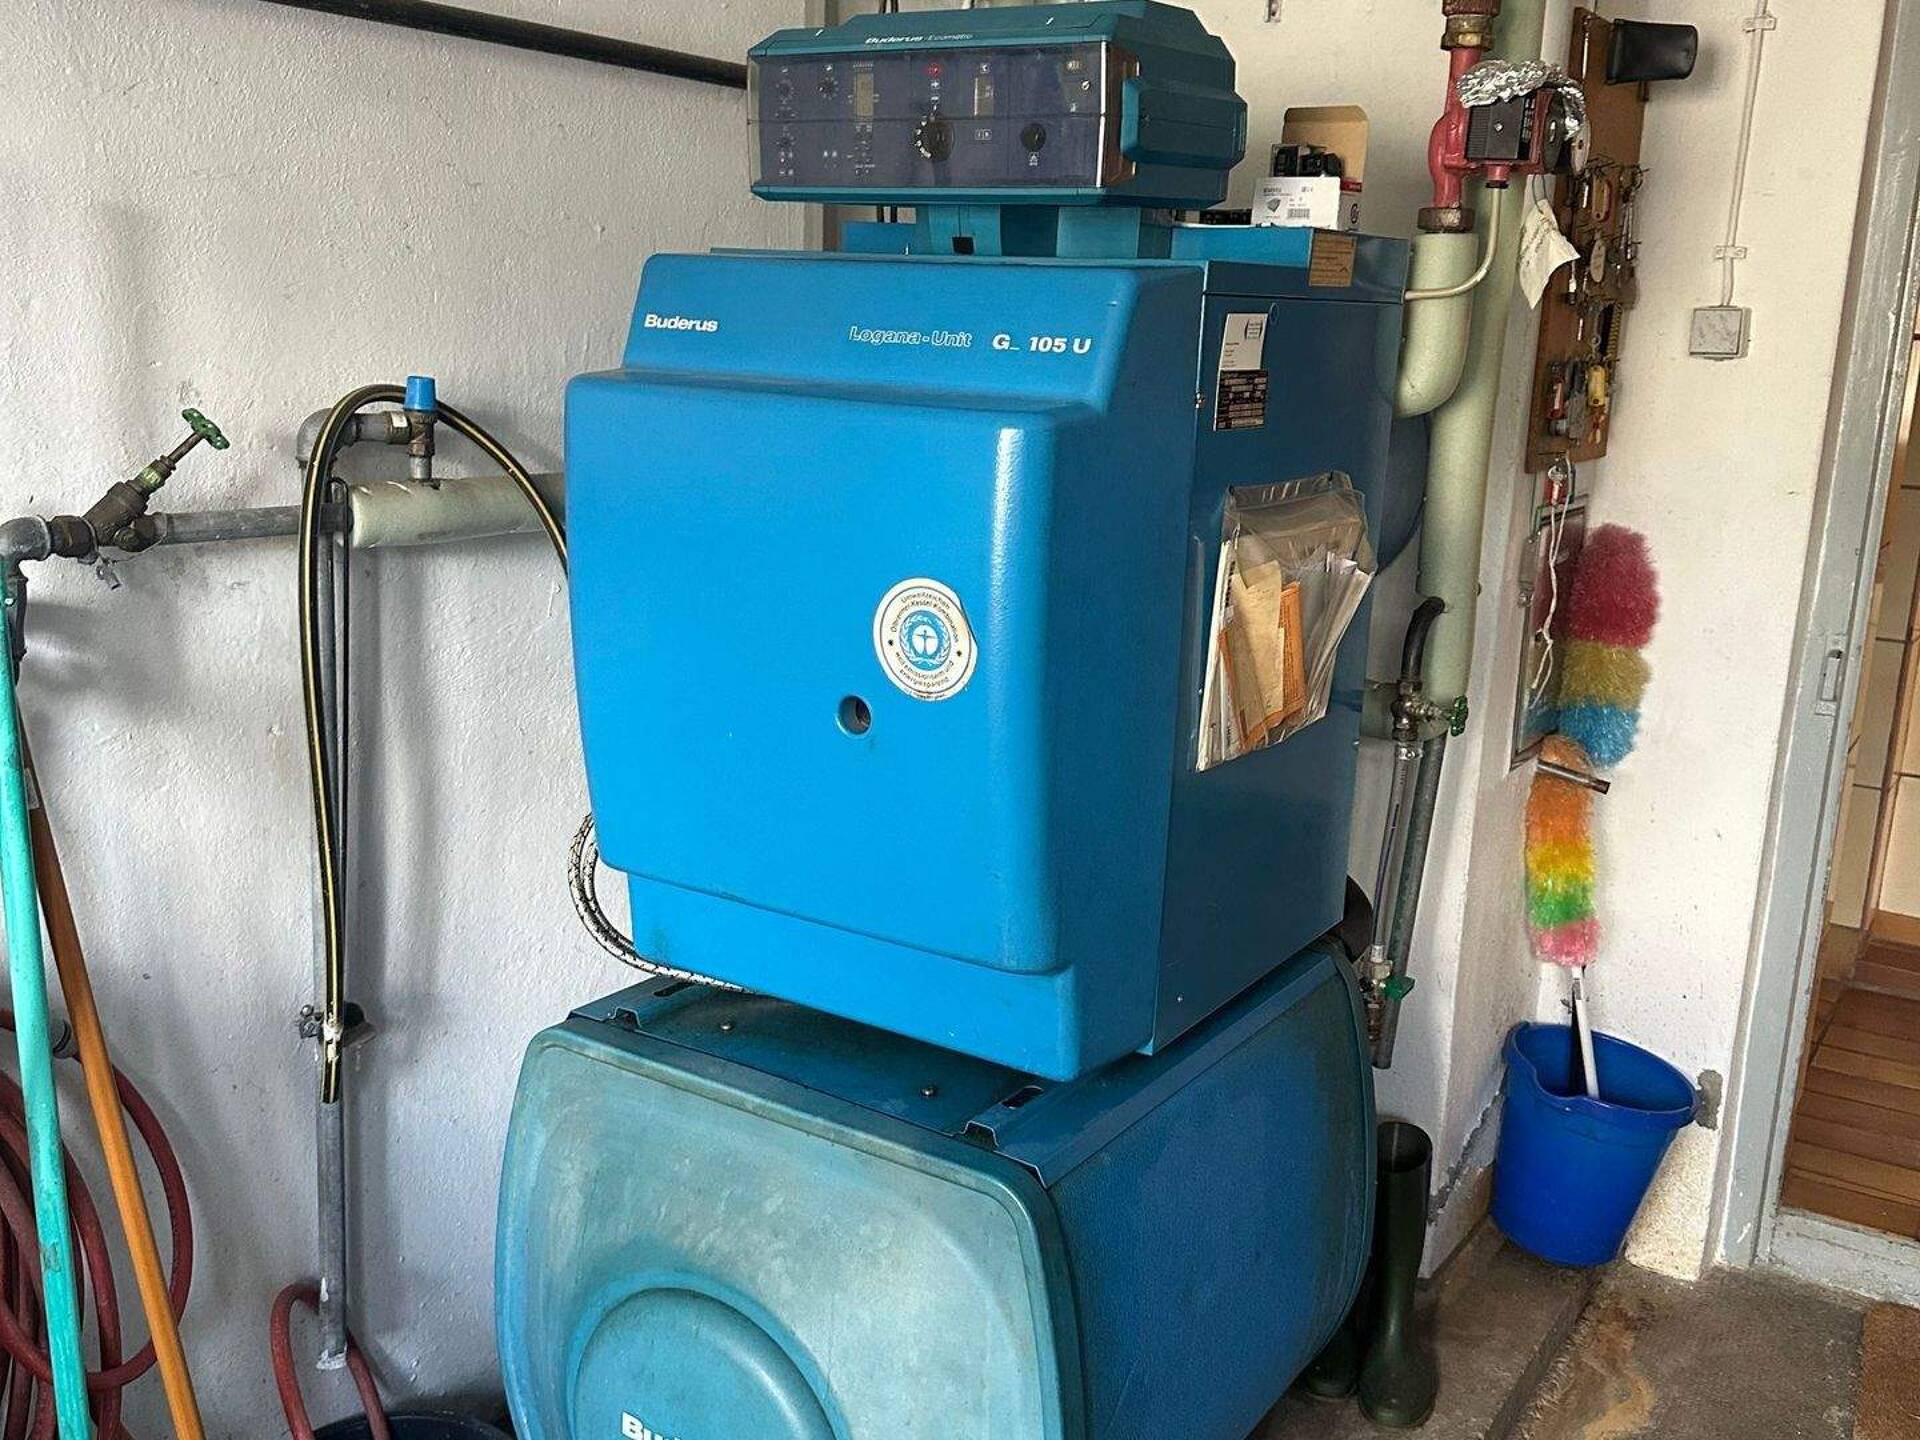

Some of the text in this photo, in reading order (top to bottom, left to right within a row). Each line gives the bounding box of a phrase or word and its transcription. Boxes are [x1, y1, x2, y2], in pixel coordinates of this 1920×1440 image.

[864, 36, 924, 45] Buderus
[644, 313, 718, 333] Buderus
[1028, 336, 1068, 353] 105
[1072, 338, 1092, 354] U
